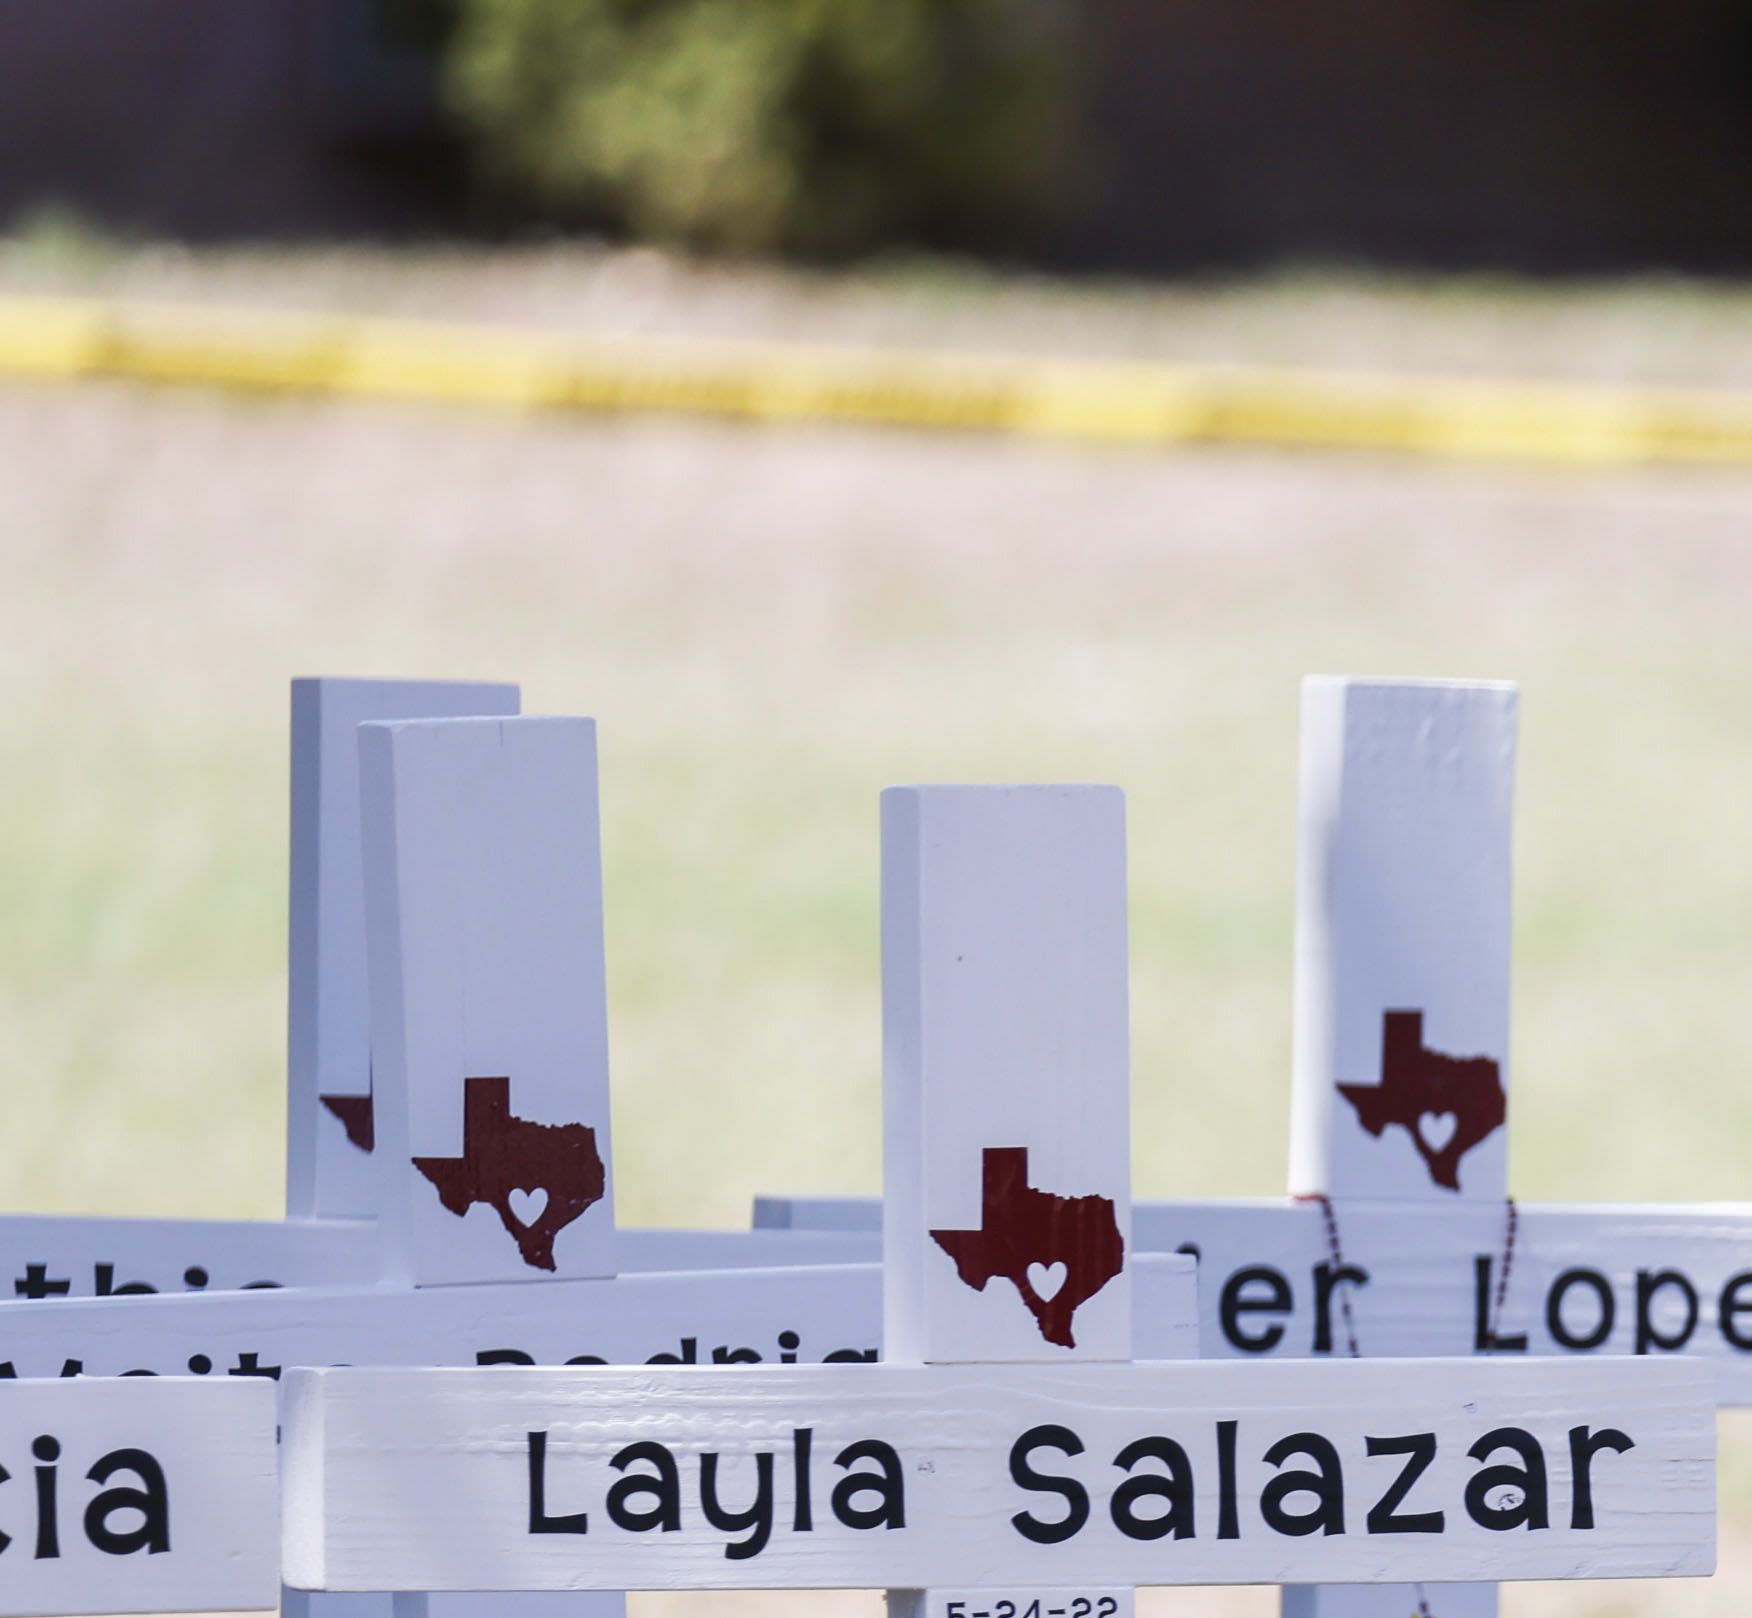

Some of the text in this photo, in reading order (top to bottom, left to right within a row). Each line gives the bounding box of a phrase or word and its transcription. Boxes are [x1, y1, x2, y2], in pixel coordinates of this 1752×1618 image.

[1176, 1244, 1369, 1355] er
[0, 1434, 171, 1560] ia
[528, 1420, 1635, 1560] Layla Salazar
